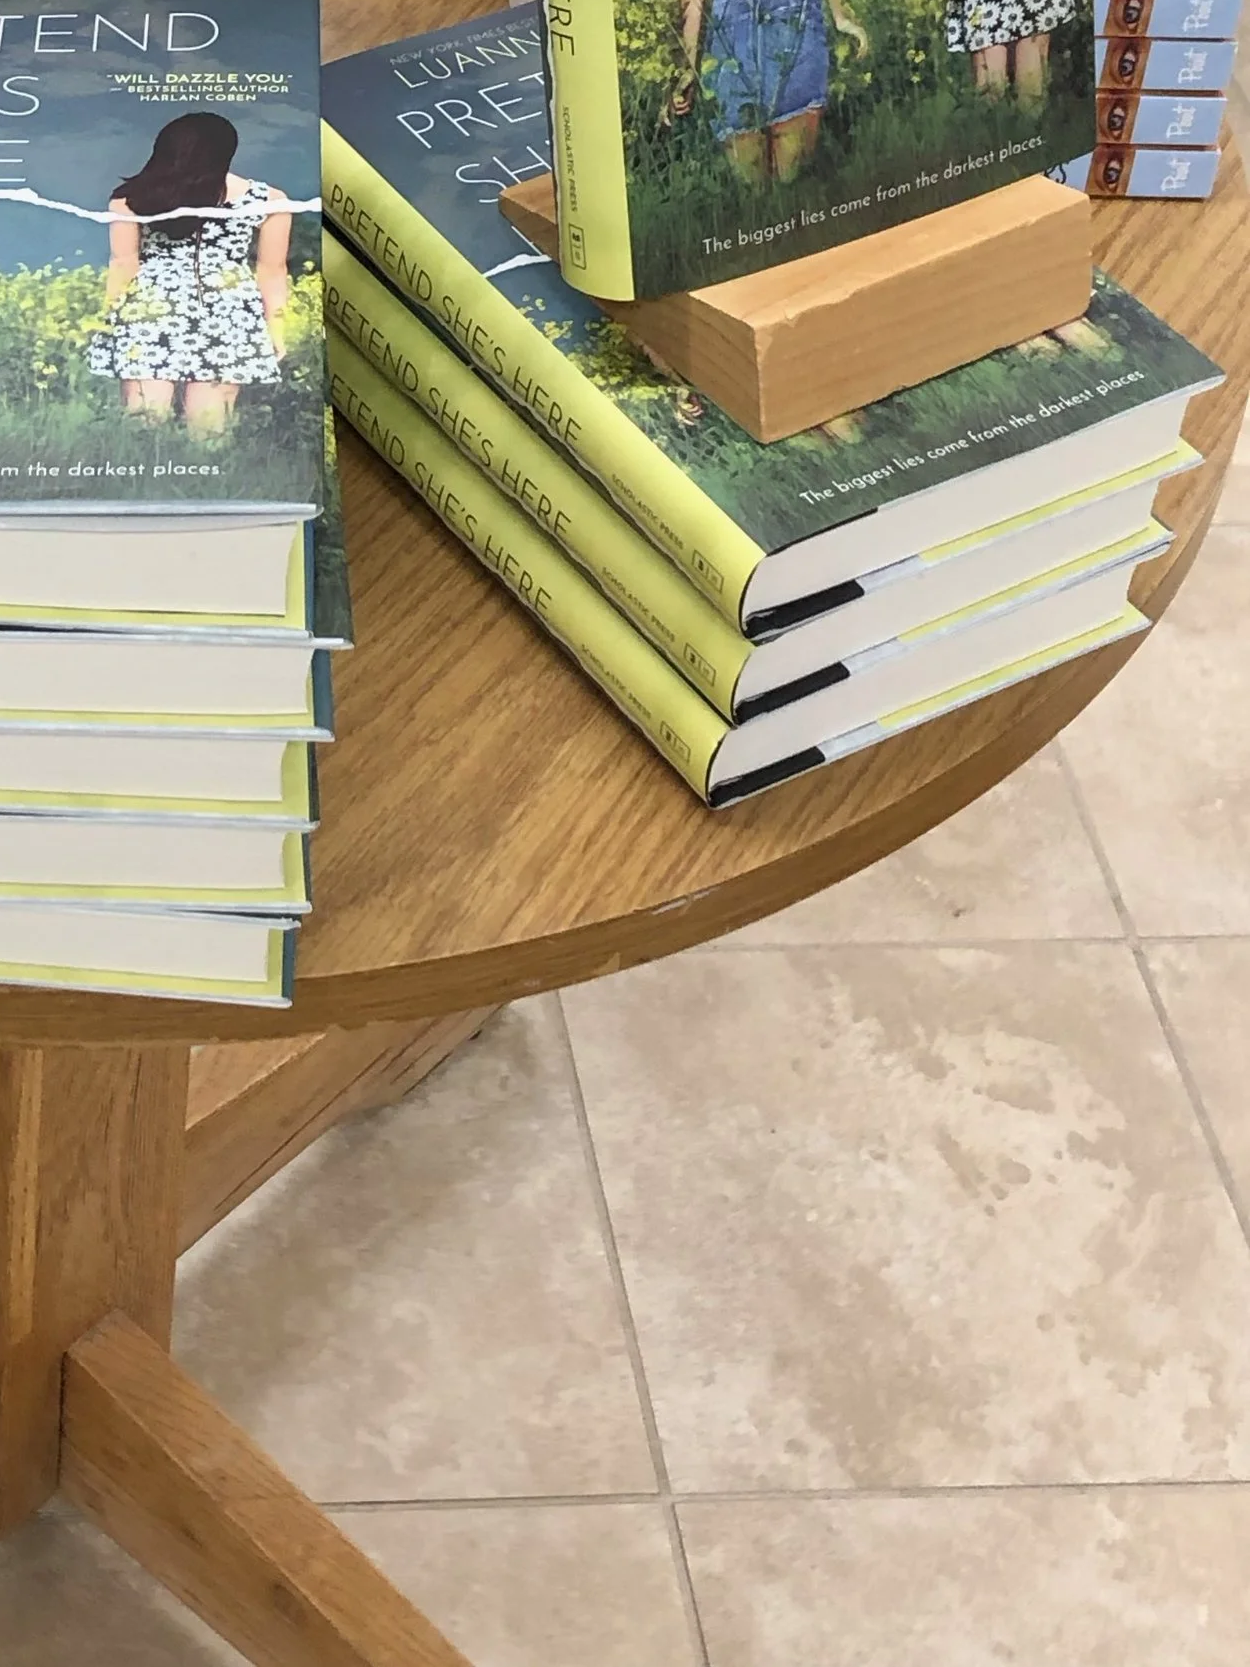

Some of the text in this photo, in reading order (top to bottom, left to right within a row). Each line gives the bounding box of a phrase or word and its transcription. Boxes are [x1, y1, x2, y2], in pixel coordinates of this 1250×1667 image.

[166, 73, 238, 84] DAZZLE
[389, 26, 505, 66] NEW YORK TIMES
[394, 30, 541, 89] LUANN
[128, 85, 289, 94] BESTSELLING AUTHOR
[140, 94, 257, 102] HARLAN COBEN
[396, 71, 544, 149] PRET
[563, 105, 575, 176] SCHOLASTIC
[701, 236, 734, 256] The
[737, 215, 797, 247] biggest
[801, 208, 827, 227] lies
[830, 197, 872, 218] come
[876, 182, 912, 203] from
[915, 170, 940, 189] the
[943, 150, 996, 180] darkest
[330, 184, 433, 302] PRETEND
[440, 295, 507, 376] SHE'S
[513, 366, 582, 444] HERE
[27, 461, 62, 477] the
[68, 460, 145, 477] darkest
[428, 387, 494, 467] SHE'S
[501, 458, 571, 537] HERE
[799, 484, 834, 507] The
[835, 462, 896, 495] biggest
[895, 451, 926, 473] lies
[926, 441, 970, 462] come
[967, 422, 1009, 446] from
[1008, 411, 1037, 432] the
[1038, 387, 1093, 421] darkest
[330, 372, 405, 466] ETEND
[413, 462, 478, 542] SHE'S
[484, 534, 553, 613] HERE
